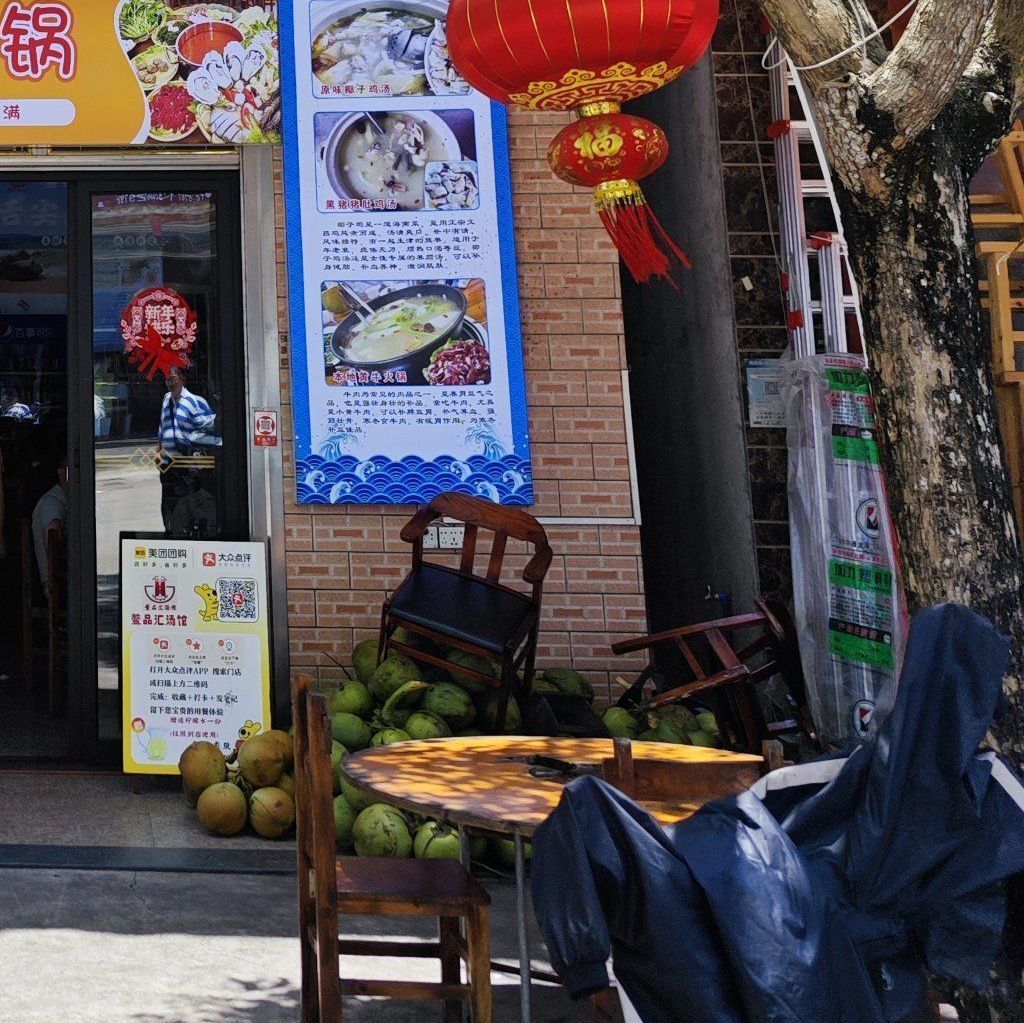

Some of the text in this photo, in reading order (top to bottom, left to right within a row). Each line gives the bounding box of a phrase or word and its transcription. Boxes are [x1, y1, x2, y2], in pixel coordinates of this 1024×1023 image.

[320, 83, 392, 96] 原味椰子鸡汤
[144, 304, 176, 320] 新年
[332, 370, 408, 384] 本地黄牛火锅
[148, 547, 188, 559] 美团团购
[218, 552, 252, 564] 大众点评
[149, 666, 209, 675] 打开大众点评APP
[149, 679, 209, 688] 或扫描上方二维码
